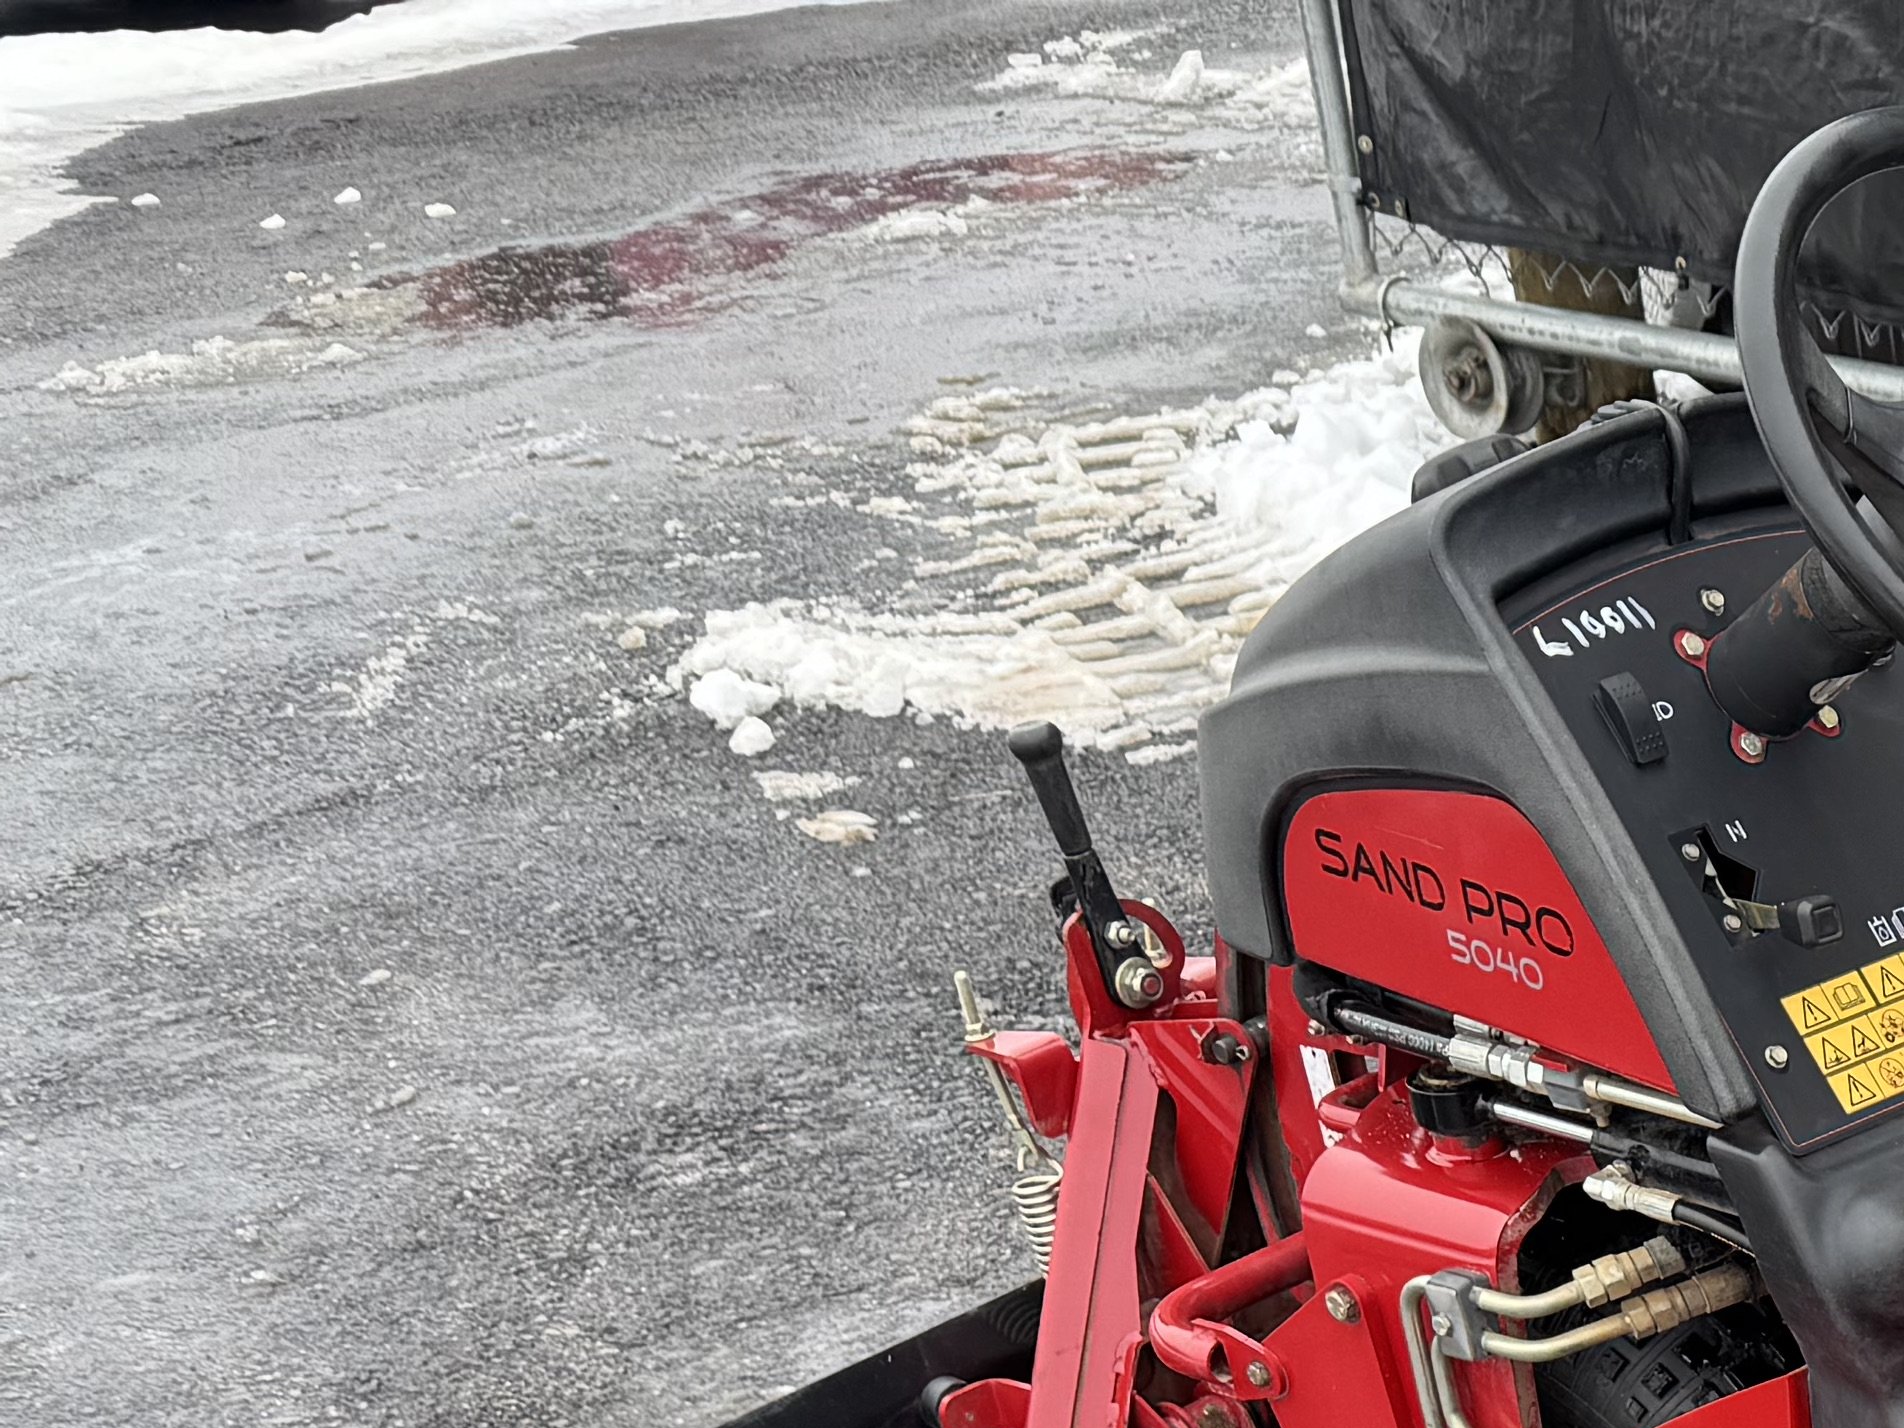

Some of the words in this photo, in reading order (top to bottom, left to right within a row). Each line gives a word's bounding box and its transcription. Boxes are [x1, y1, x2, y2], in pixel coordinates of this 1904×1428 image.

[1315, 828, 1446, 912] SAND
[1460, 878, 1575, 957] PRO
[1446, 928, 1544, 991] 5040
